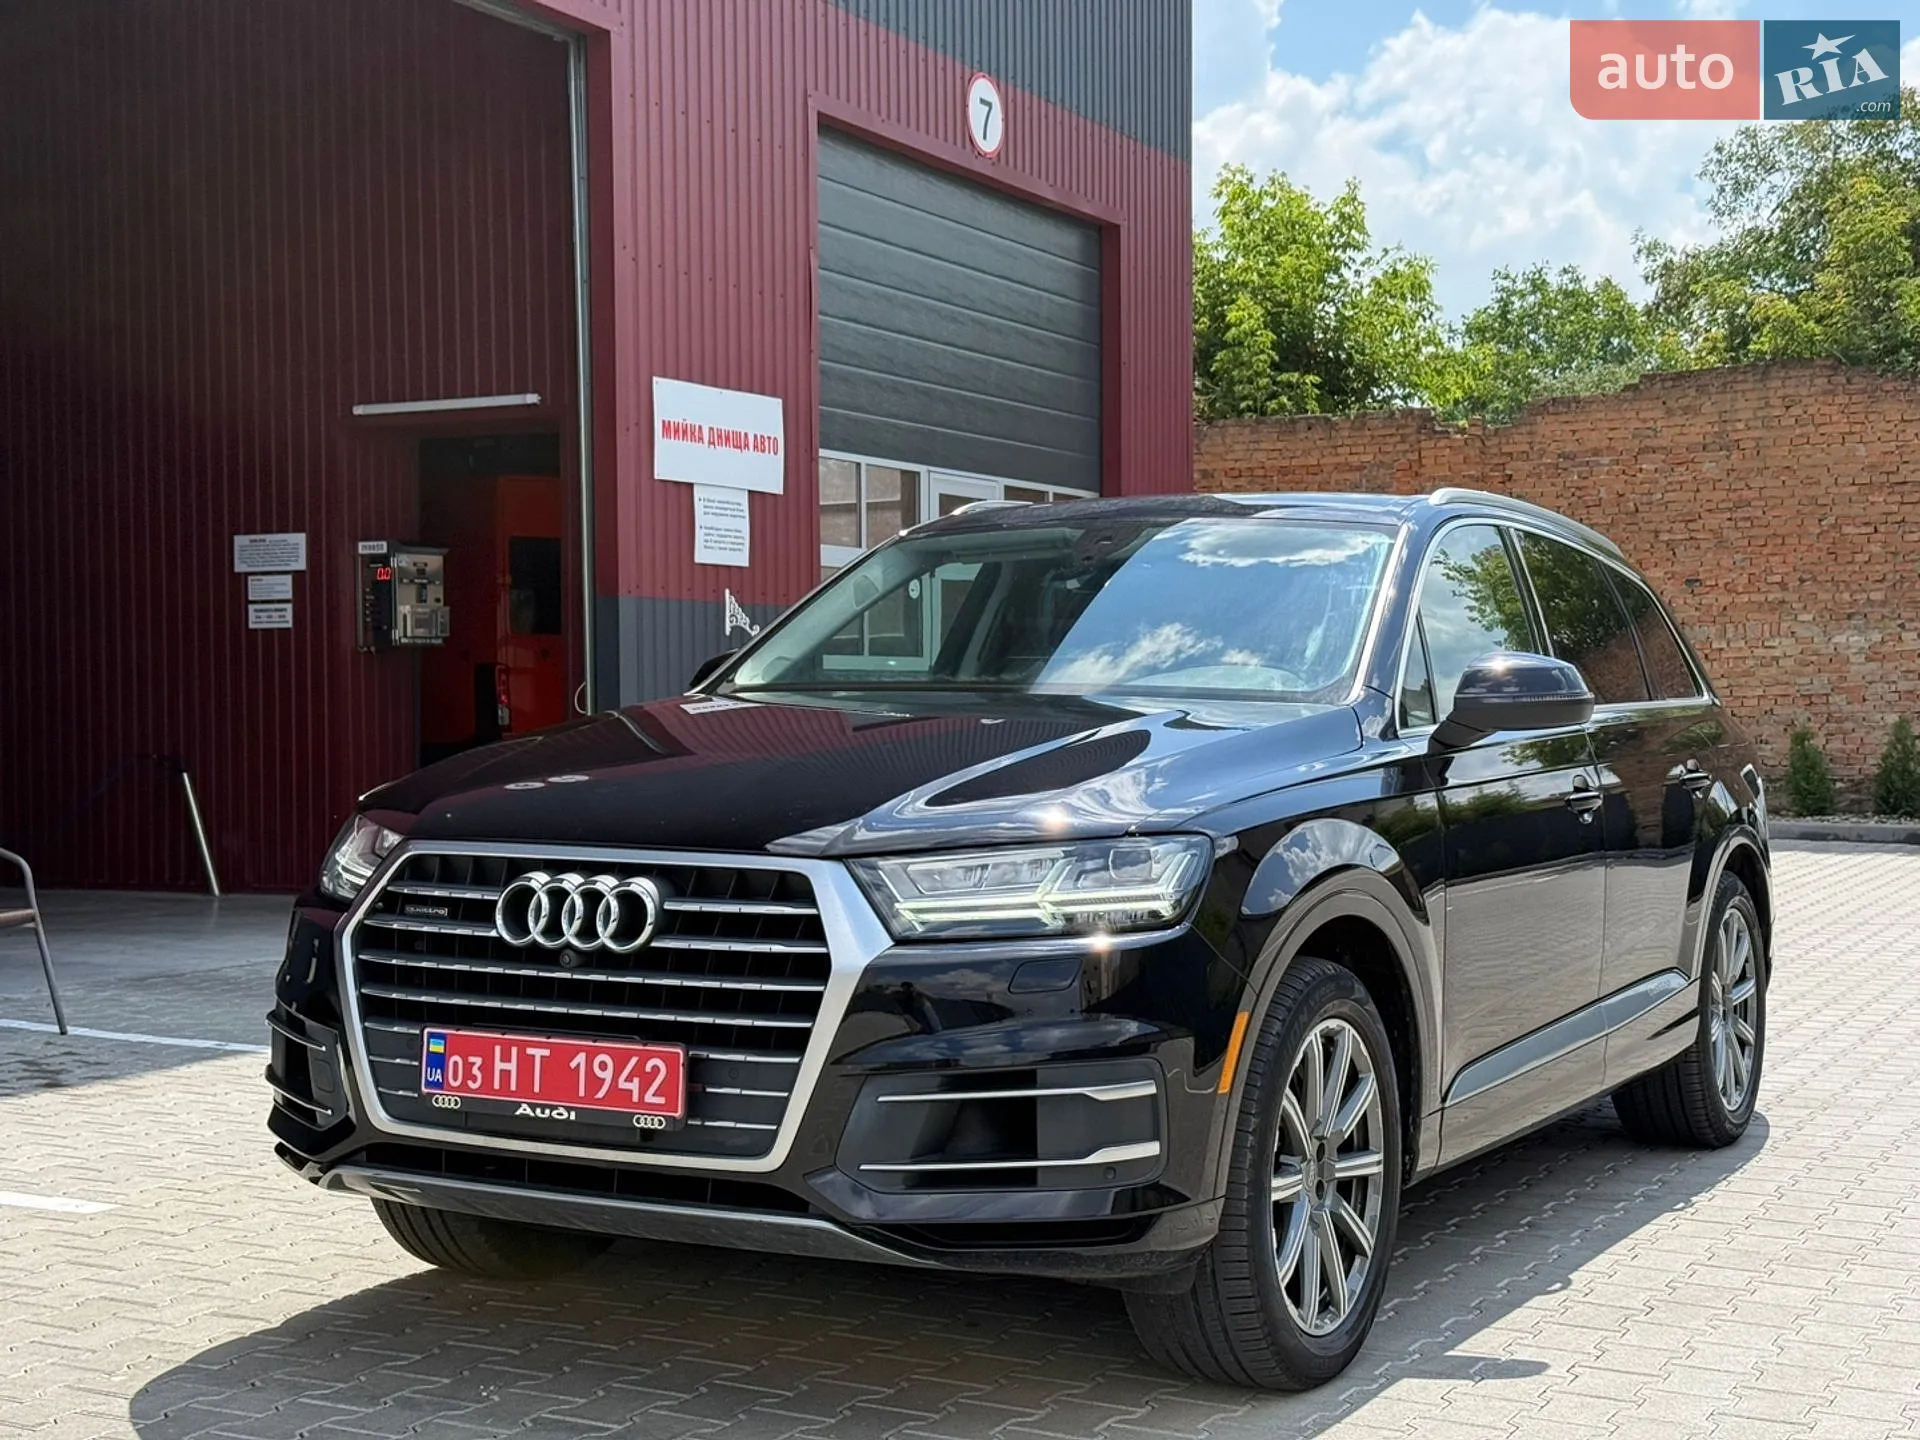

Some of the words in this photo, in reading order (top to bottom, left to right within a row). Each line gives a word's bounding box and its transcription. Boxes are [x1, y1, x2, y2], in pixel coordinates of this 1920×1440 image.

[979, 96, 993, 141] 7
[661, 418, 705, 445] МИЙКА
[707, 426, 751, 453] ДНИЩА
[753, 433, 779, 456] АВТО
[426, 1066, 443, 1083] UA
[447, 1054, 484, 1090] 03
[492, 1044, 551, 1094] HT
[568, 1051, 668, 1105] 1942
[514, 1104, 576, 1121] Audi
